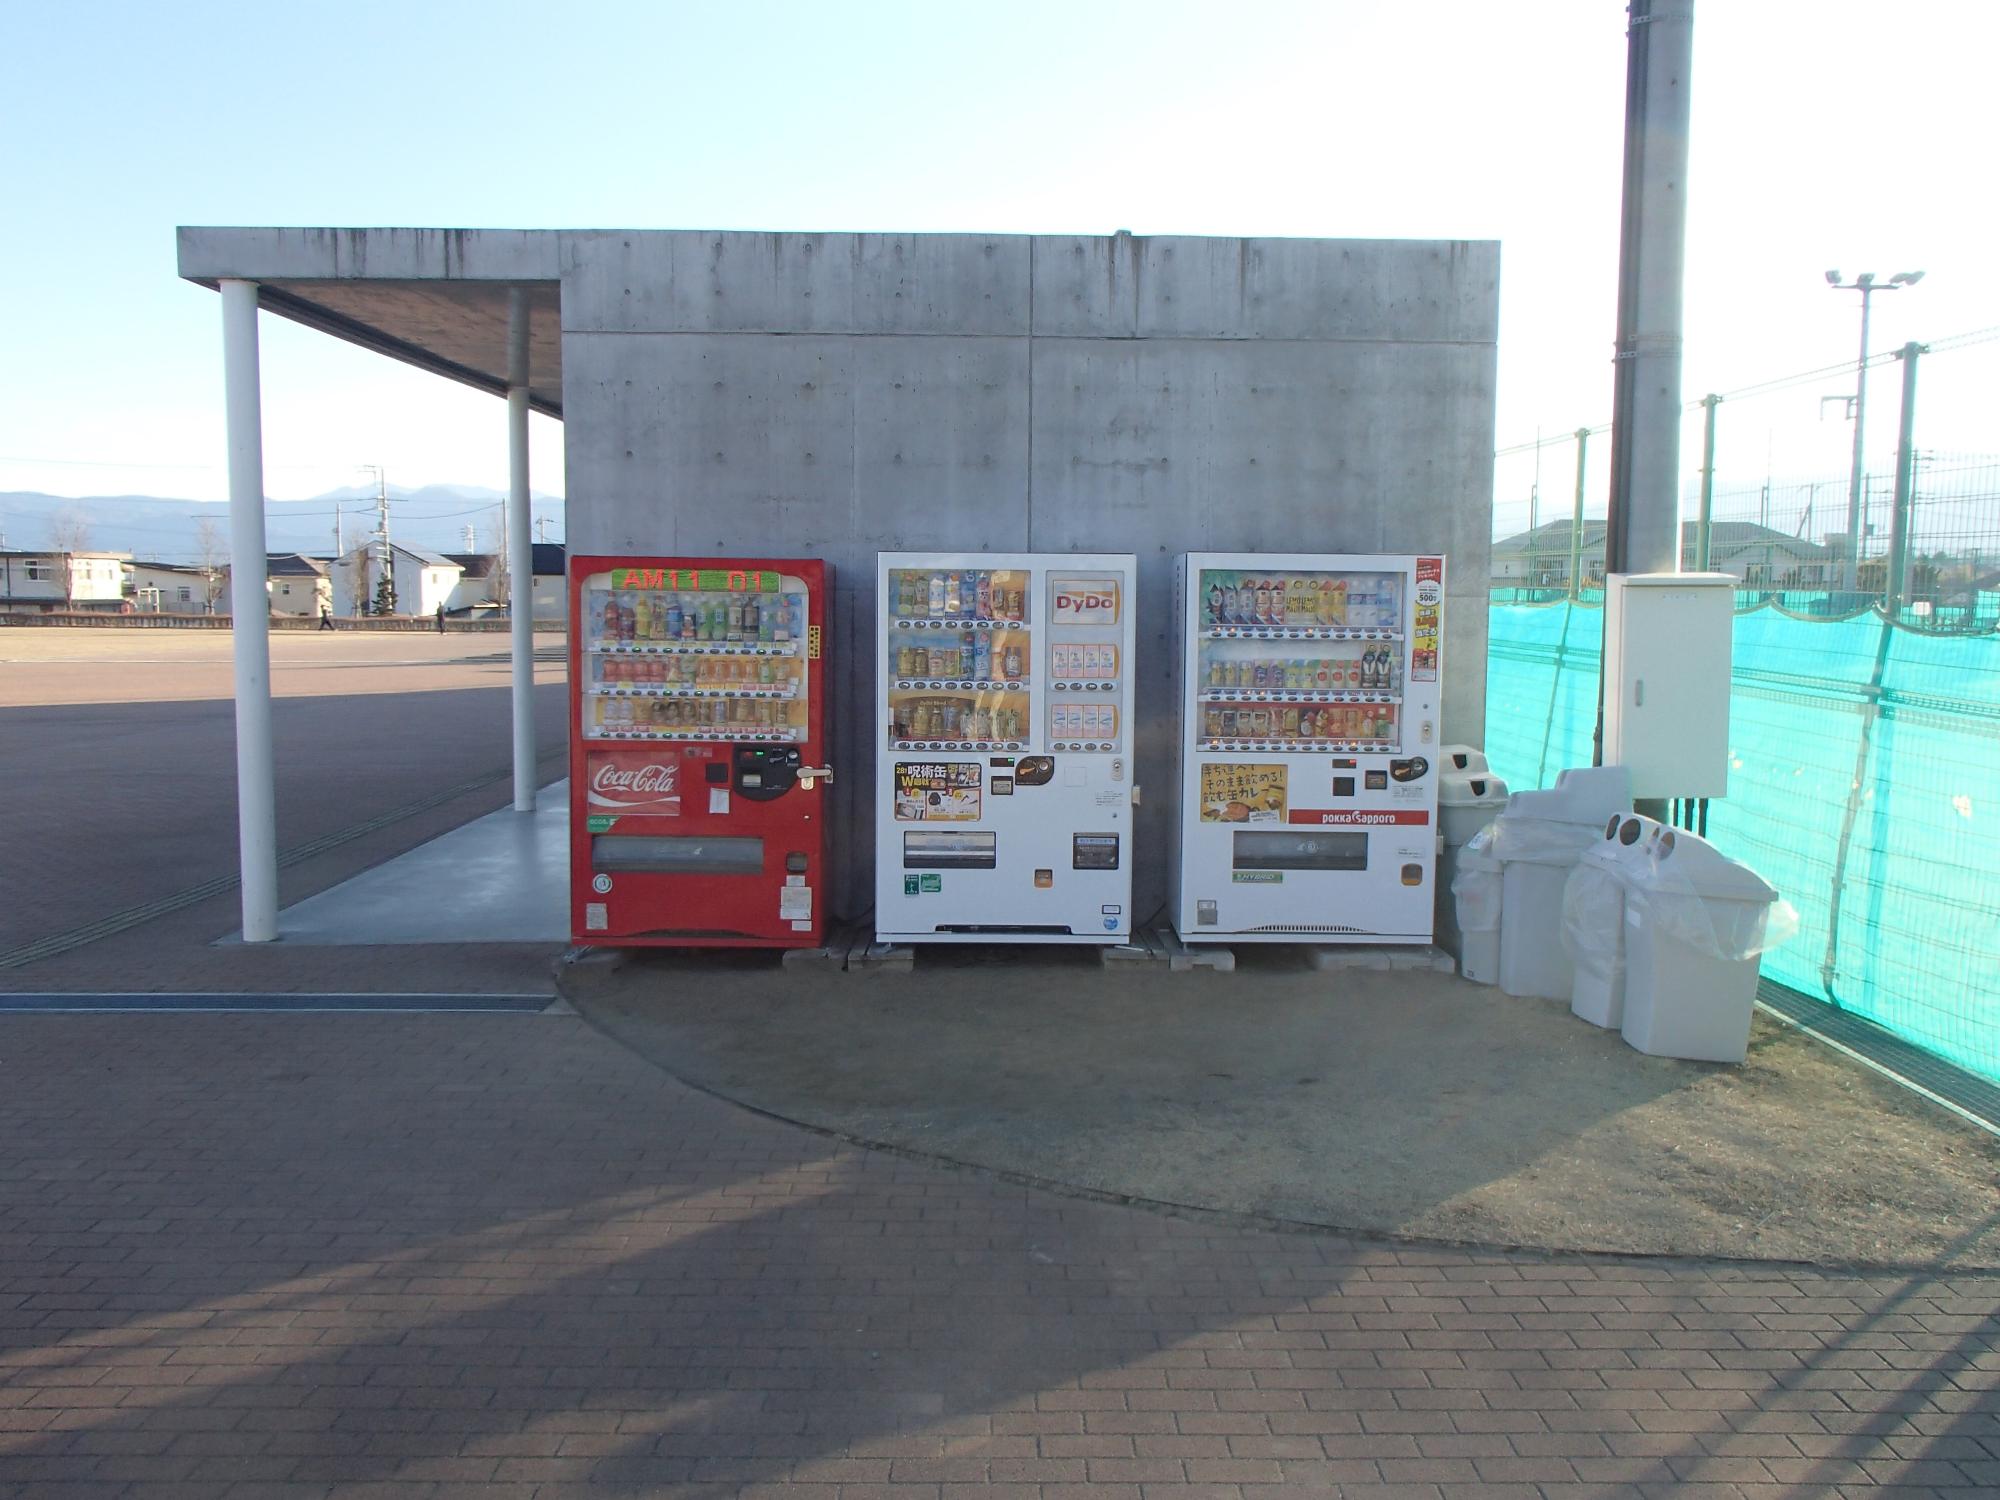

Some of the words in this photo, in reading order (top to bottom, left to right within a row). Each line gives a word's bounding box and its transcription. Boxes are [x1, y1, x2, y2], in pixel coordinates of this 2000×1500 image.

[1056, 595, 1113, 613] DyDo
[593, 764, 680, 792] Coca-Cola
[908, 764, 947, 779] 呪術缶
